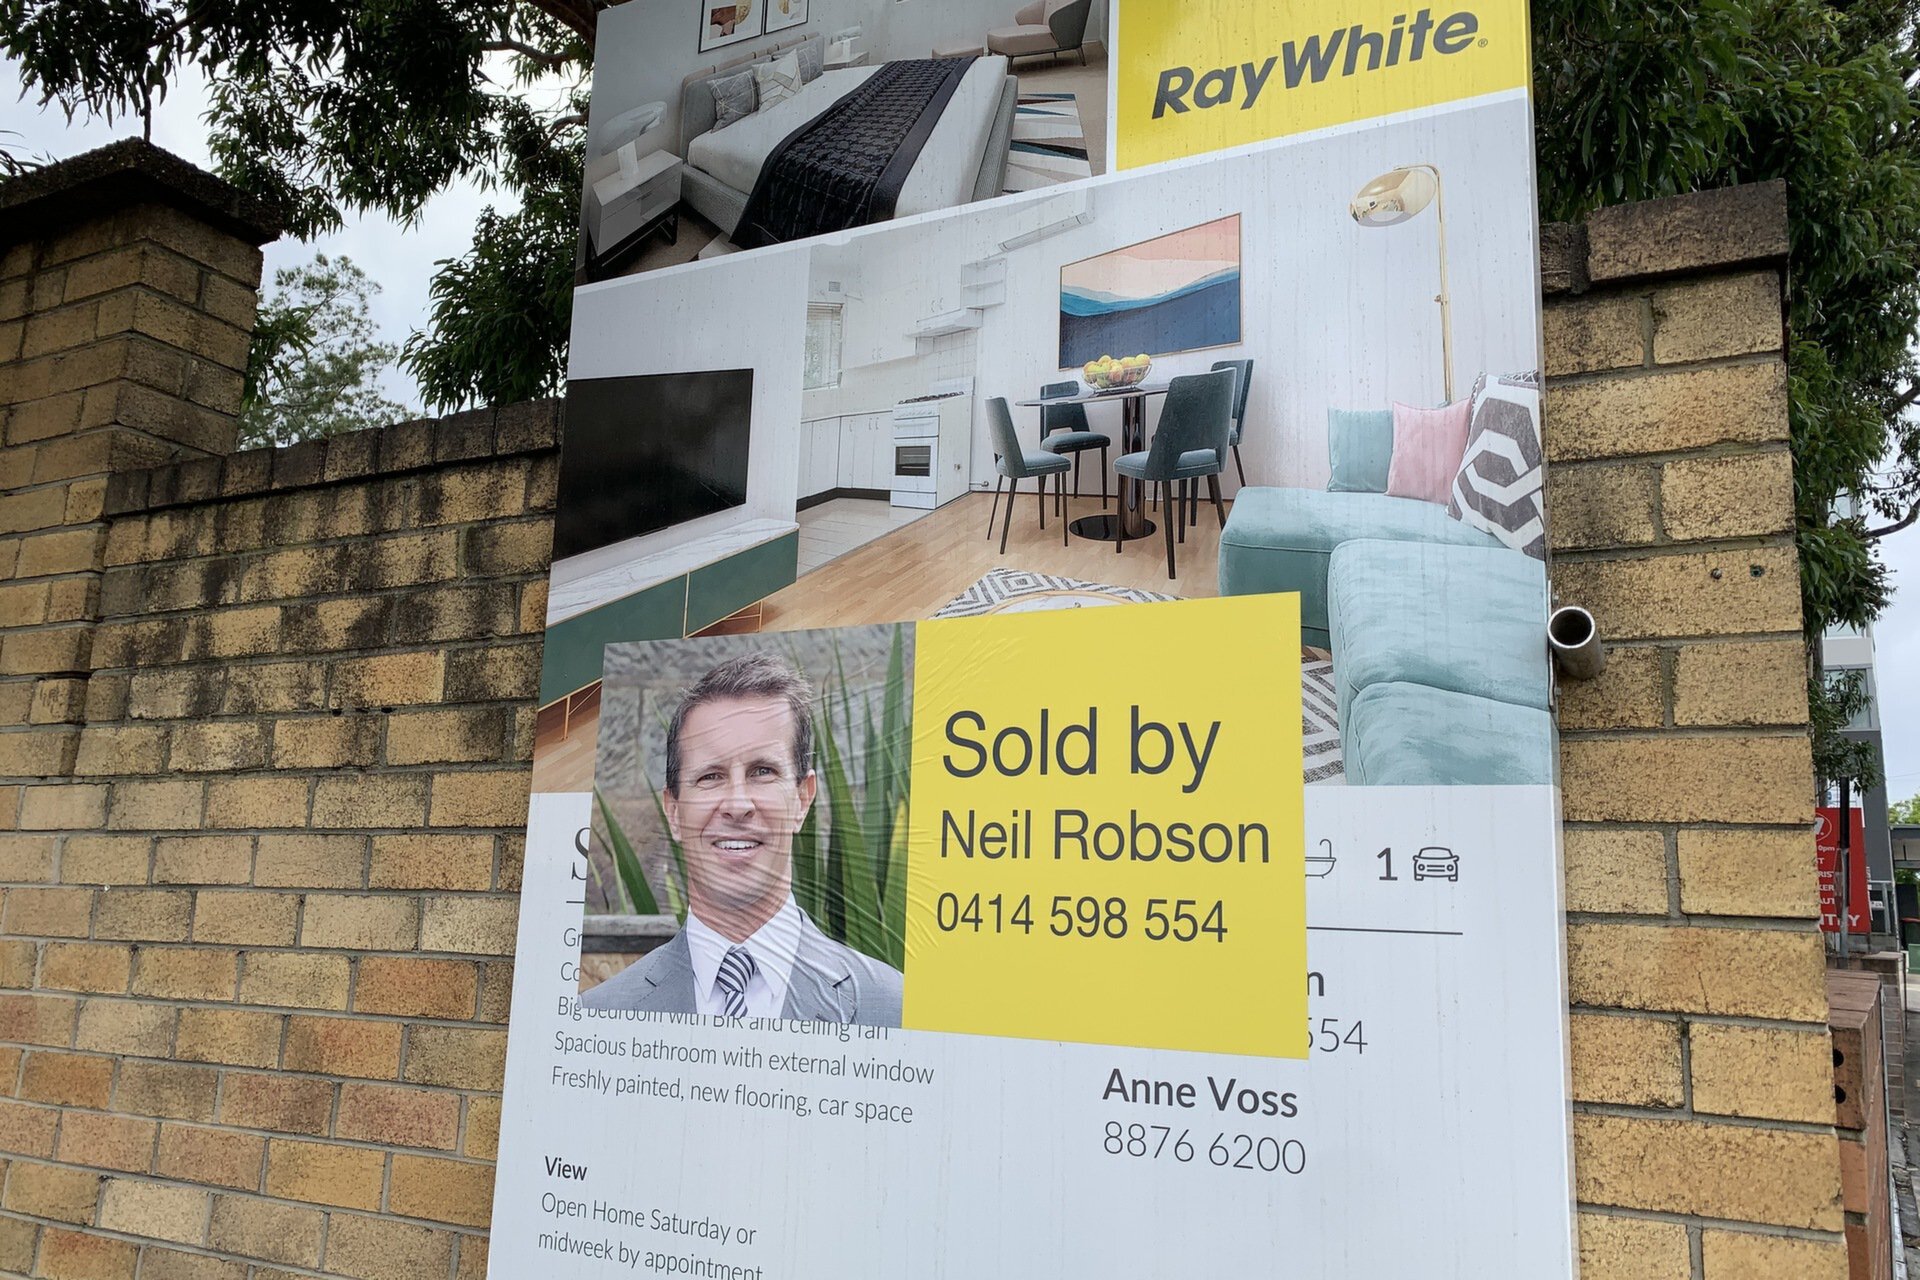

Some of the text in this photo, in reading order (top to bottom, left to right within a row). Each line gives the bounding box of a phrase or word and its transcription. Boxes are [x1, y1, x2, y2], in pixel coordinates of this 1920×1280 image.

[942, 705, 1221, 793] Sold by
[940, 810, 1270, 863] Neil Robson
[1376, 847, 1398, 881] 1
[937, 892, 1228, 943] 0414 598 554
[558, 996, 582, 1021] Big
[554, 1031, 934, 1084] Spacious bathroom with external window
[552, 1065, 913, 1123] Freshly painted, new flooring, car space
[1103, 1068, 1298, 1118] Anne Voss
[545, 1156, 587, 1181] View
[1104, 1121, 1306, 1174] 8876 6200
[541, 1192, 757, 1245] Open Home Saturday or
[538, 1231, 763, 1280] midweek by appointment
